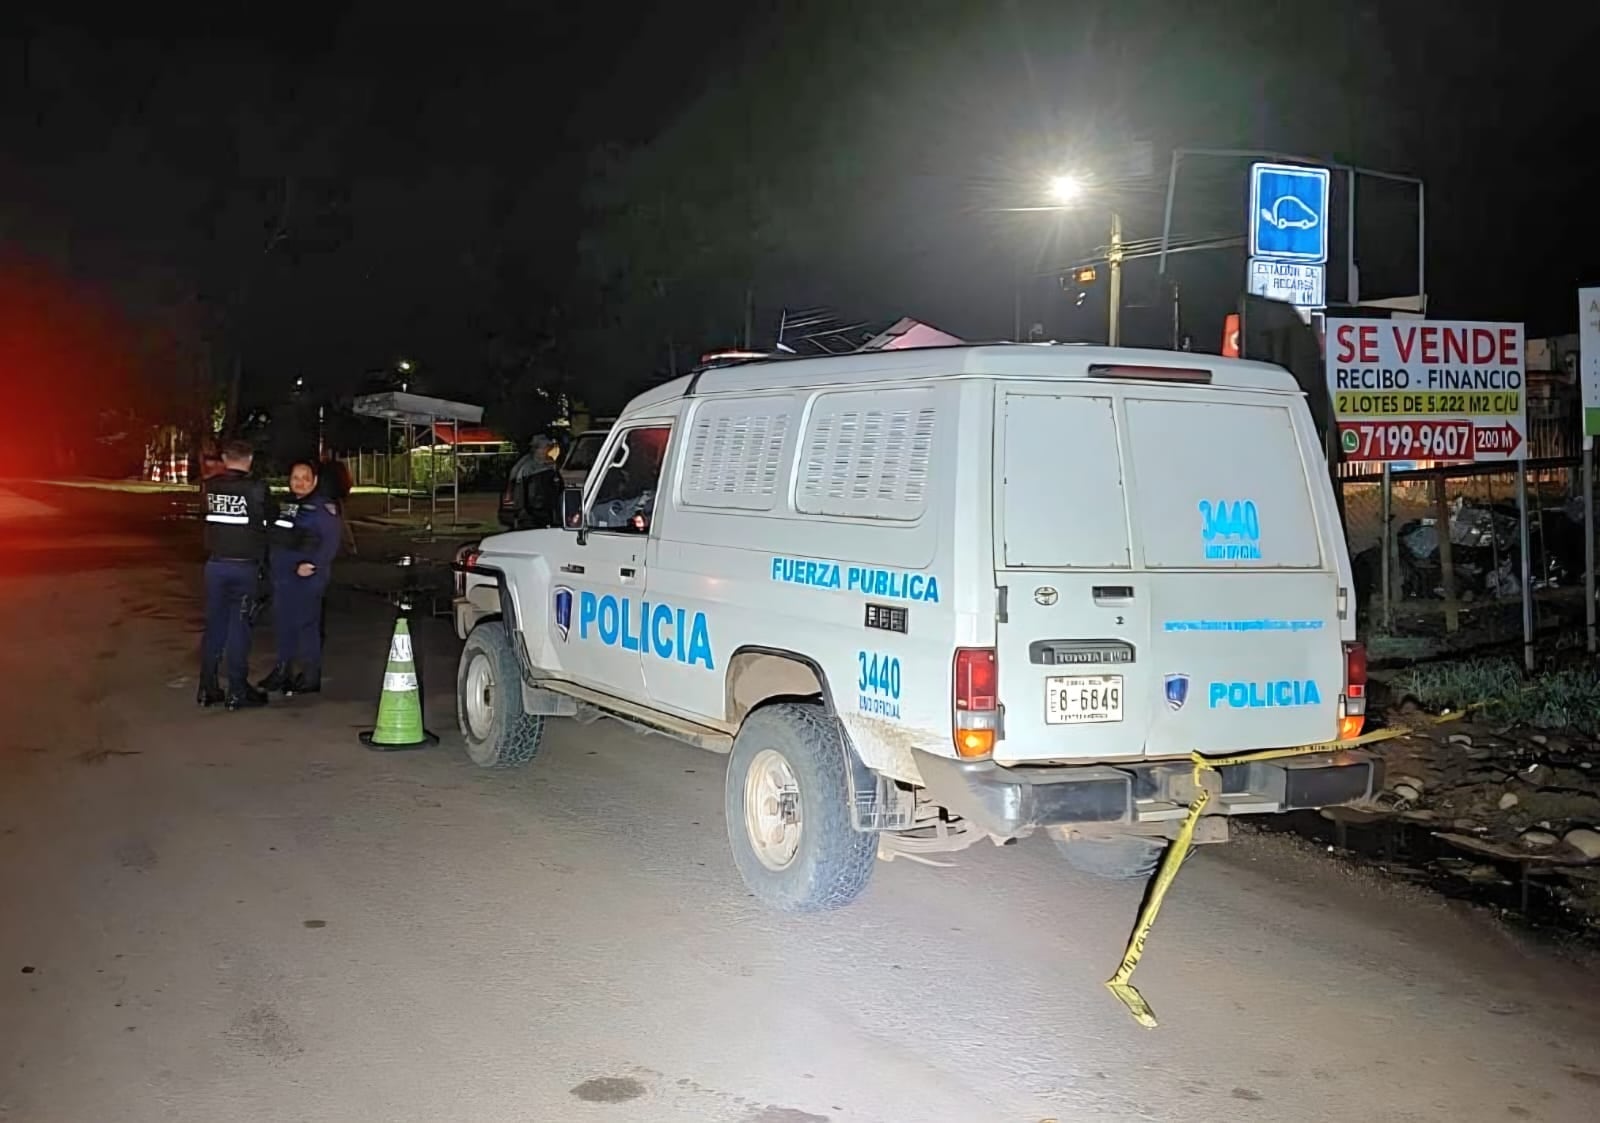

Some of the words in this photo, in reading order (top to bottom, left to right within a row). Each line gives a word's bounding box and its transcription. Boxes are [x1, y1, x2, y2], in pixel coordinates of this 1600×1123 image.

[1336, 325, 1379, 363] SE
[1392, 326, 1518, 365] VENDE
[1336, 369, 1409, 389] RECIBO
[1428, 370, 1521, 390] FINANCIO
[1339, 396, 1348, 413] 2
[1352, 396, 1398, 413] LOTES
[1403, 396, 1423, 413] DE
[1469, 396, 1490, 413] M2
[1494, 396, 1519, 412] C/U
[1360, 425, 1469, 456] 7199-9607
[1477, 431, 1499, 449] 200
[1502, 430, 1513, 448] M
[1199, 500, 1259, 540] 3440
[772, 558, 841, 588] FUERZA
[848, 567, 940, 603] PUBLICA
[579, 591, 715, 670] POLICIA
[858, 650, 901, 700] 3440
[1060, 687, 1119, 712] 8-6849
[1210, 680, 1321, 709] POLICIA
